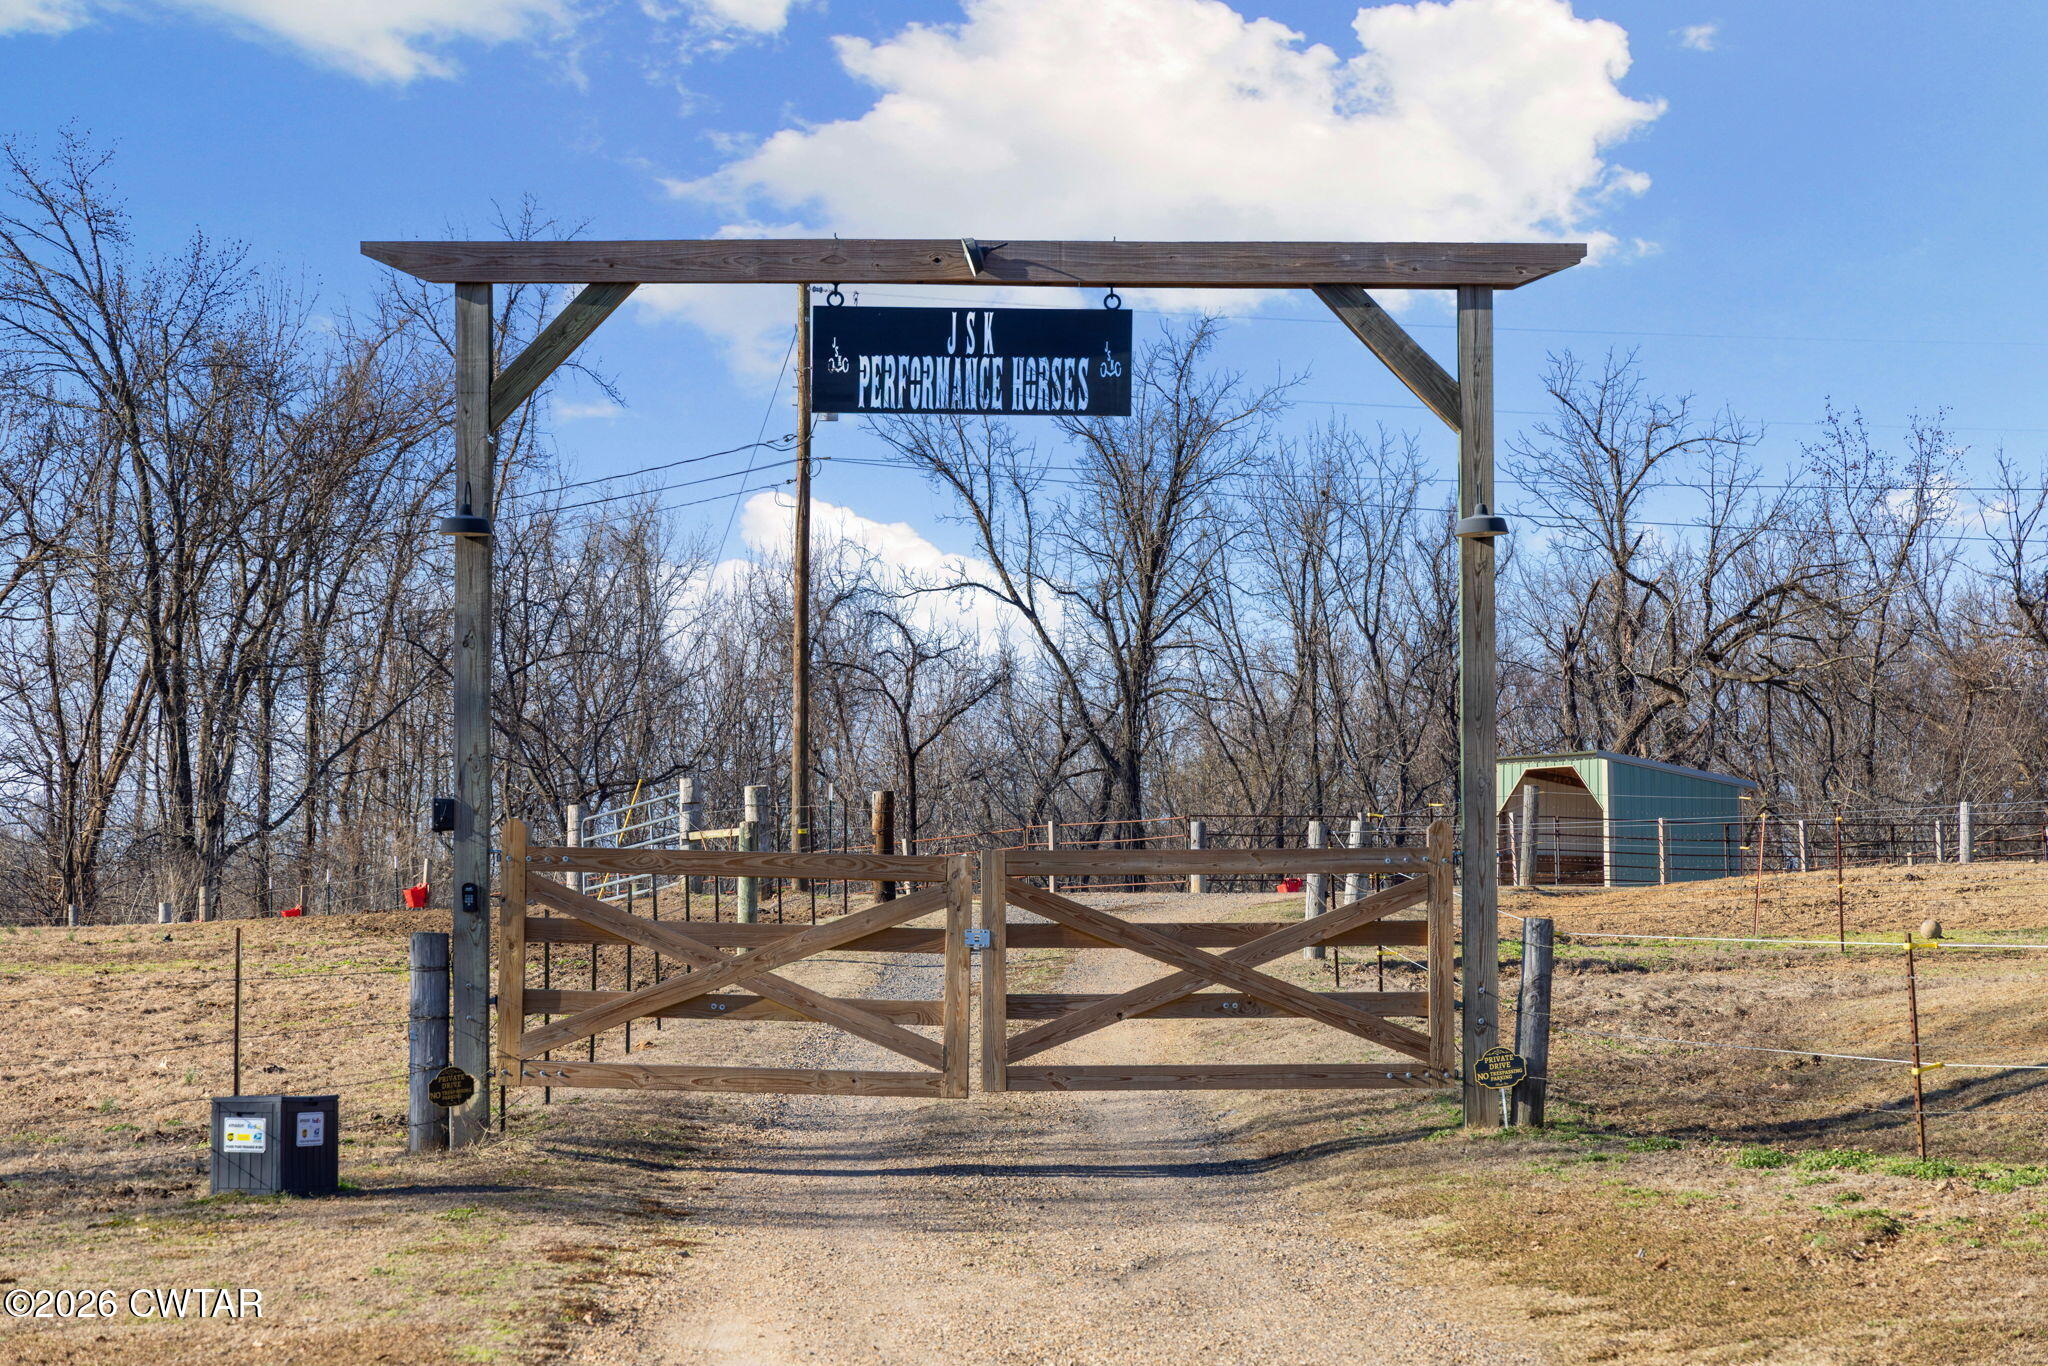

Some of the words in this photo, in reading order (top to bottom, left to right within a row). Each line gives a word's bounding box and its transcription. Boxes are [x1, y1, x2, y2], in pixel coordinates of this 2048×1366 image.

[858, 355, 1003, 410] PERFORMANCE
[1011, 357, 1090, 412] HORSES
[1484, 1054, 1514, 1064] PRIVATE
[1489, 1062, 1511, 1070] DRIVE
[1477, 1072, 1489, 1081] NO
